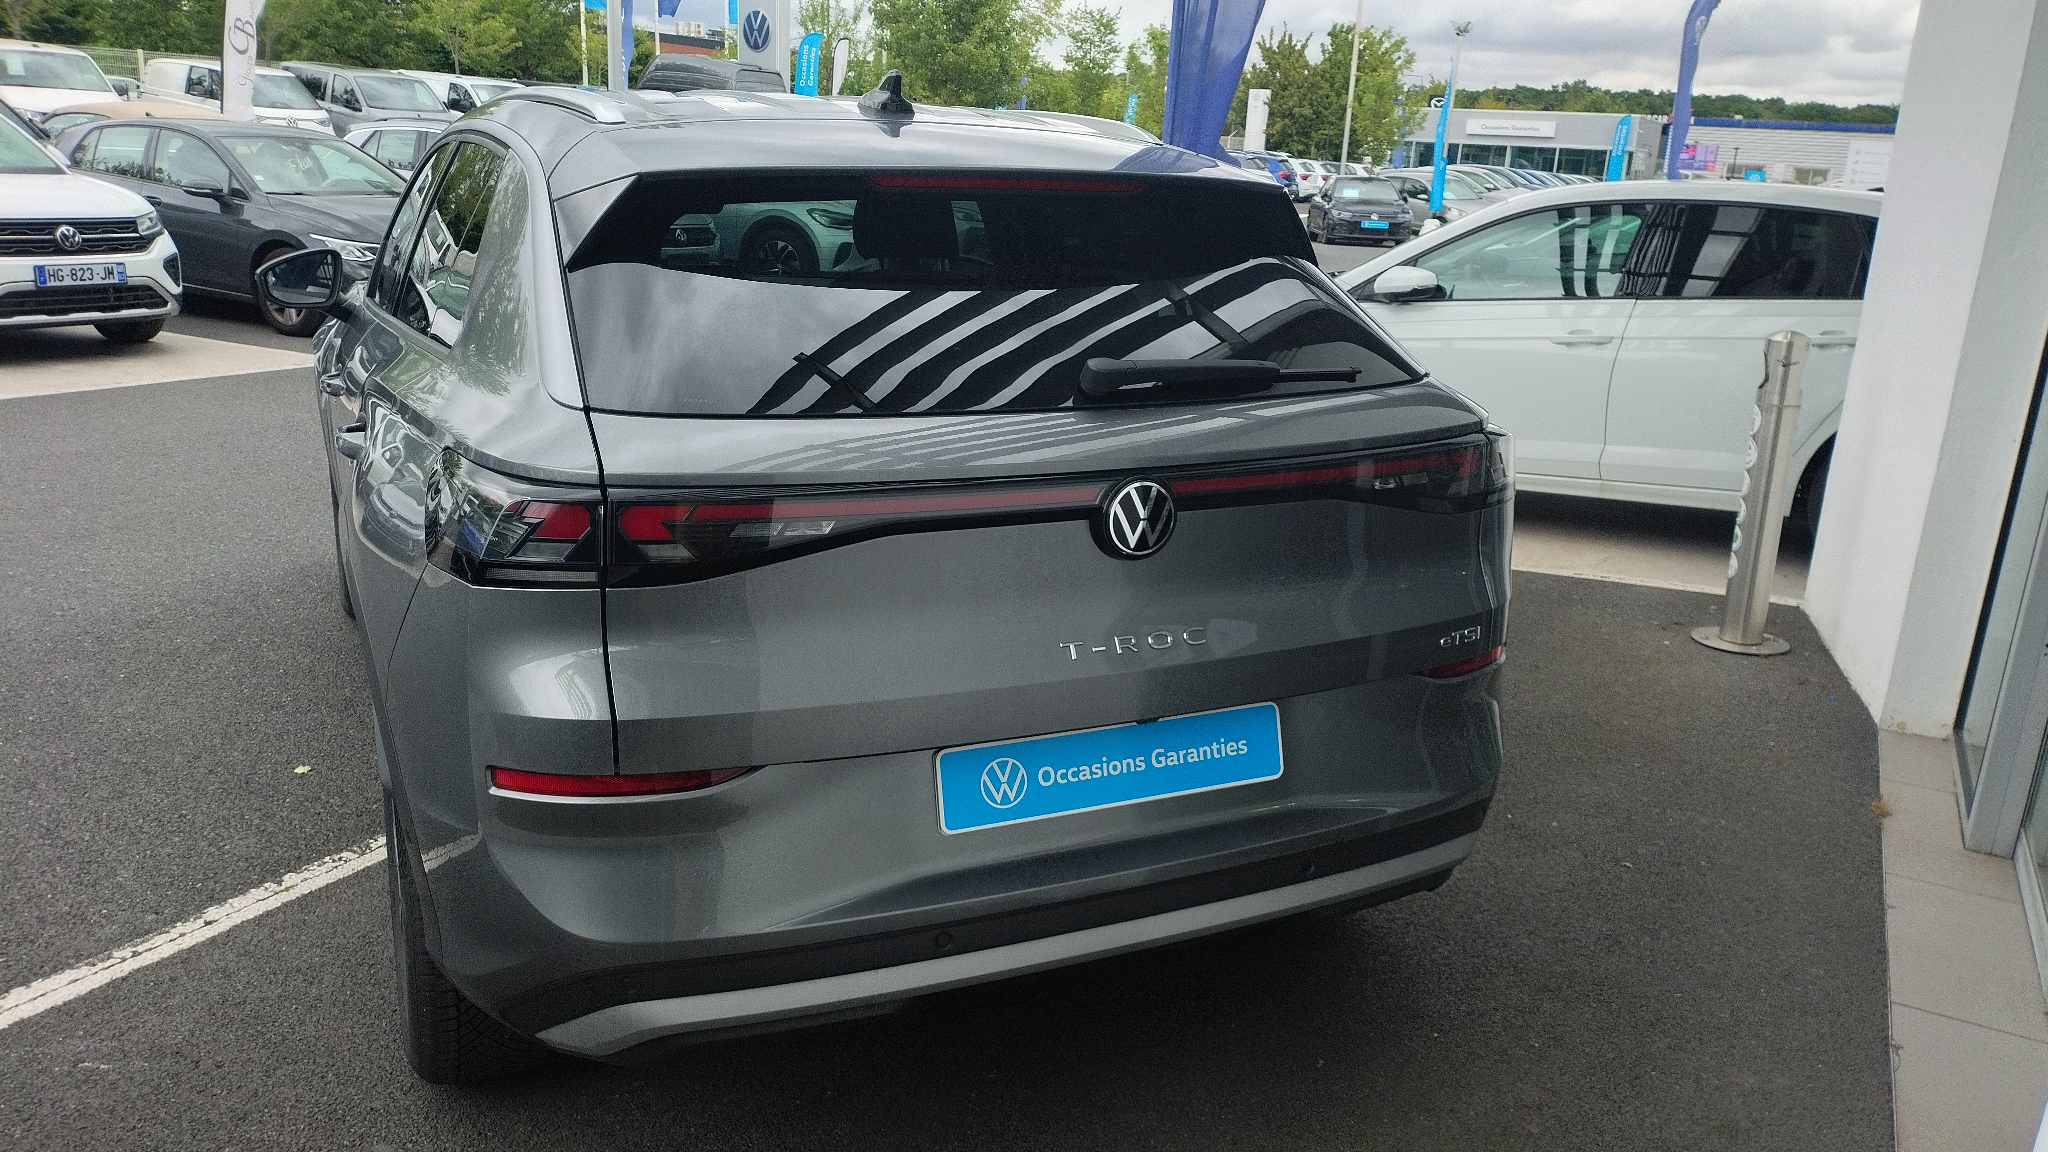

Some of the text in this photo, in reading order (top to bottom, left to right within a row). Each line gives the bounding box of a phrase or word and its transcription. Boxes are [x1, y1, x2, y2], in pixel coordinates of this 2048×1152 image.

[800, 45, 809, 86] Occasions
[808, 47, 816, 86] Garanties
[1059, 627, 1207, 661] T-ROC
[1440, 625, 1481, 648] eTSI
[1037, 757, 1146, 787] Occasions
[1151, 738, 1248, 768] Garanties
